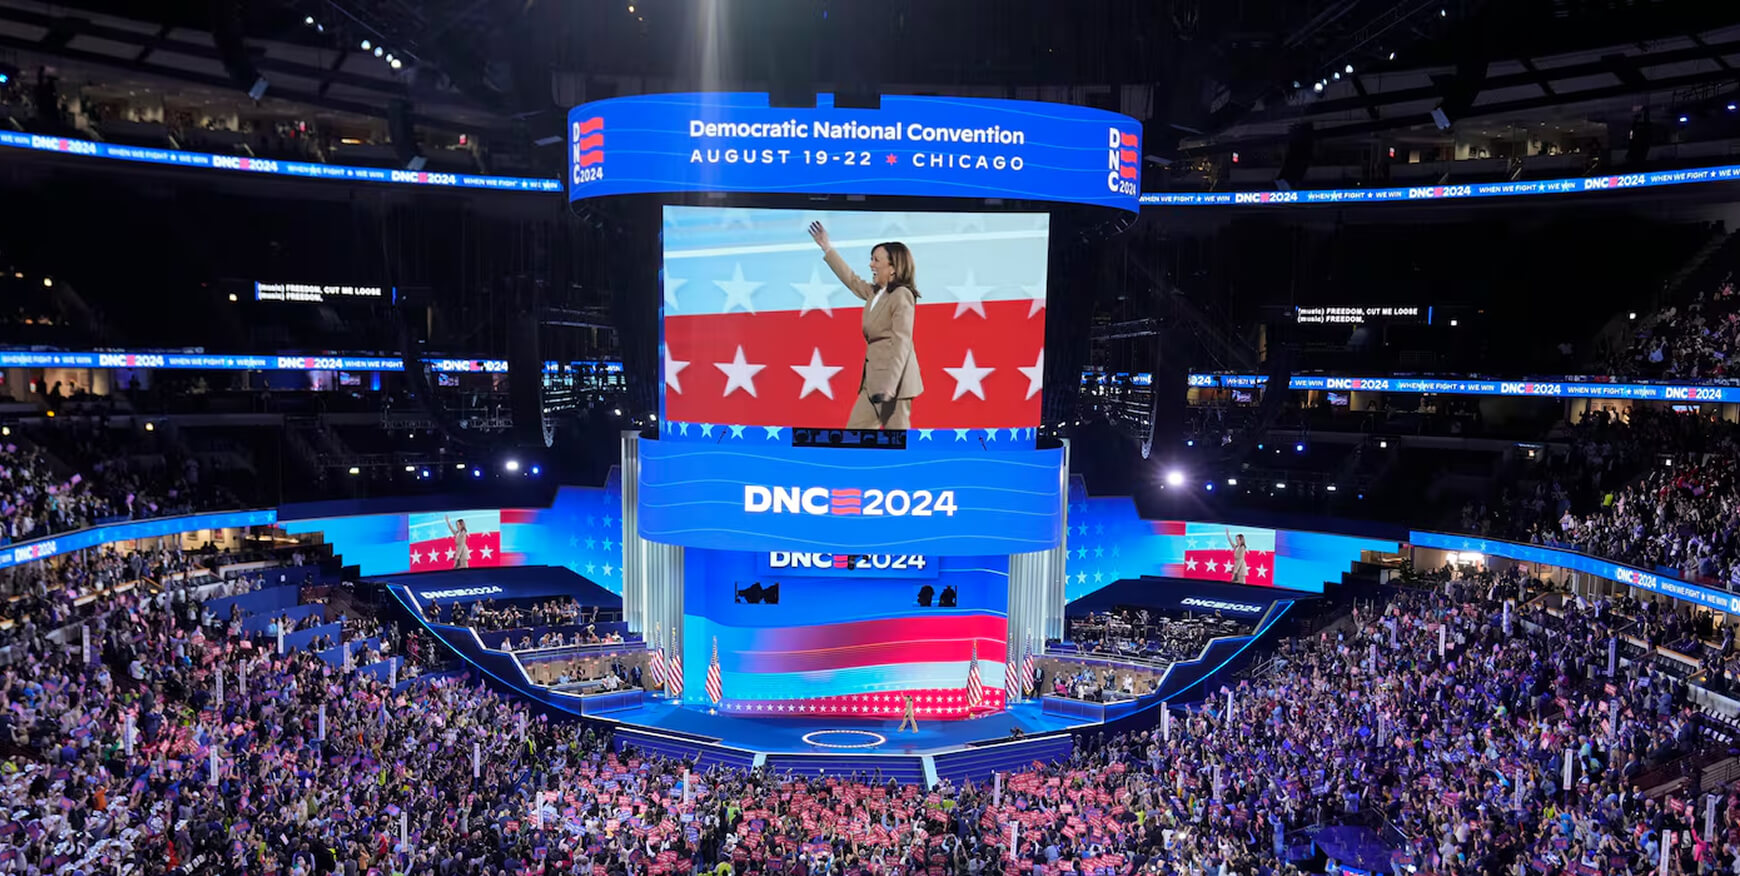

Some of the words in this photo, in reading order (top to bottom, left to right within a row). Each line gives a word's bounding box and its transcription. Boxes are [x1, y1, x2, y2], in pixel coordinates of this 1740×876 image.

[690, 119, 808, 137] Democratic
[813, 121, 902, 140] National
[907, 123, 1024, 144] Convention
[690, 149, 790, 164] AUGUST
[803, 150, 871, 165] 19-22
[912, 153, 1024, 171] CHICAGO
[581, 167, 603, 183] 2024
[1674, 173, 1685, 181] WE
[1686, 171, 1708, 179] FIGHT
[1120, 180, 1136, 196] 2024
[324, 286, 340, 294] CUT
[341, 287, 353, 295] ME
[355, 288, 381, 296] LOOSE
[862, 490, 957, 516] 2024
